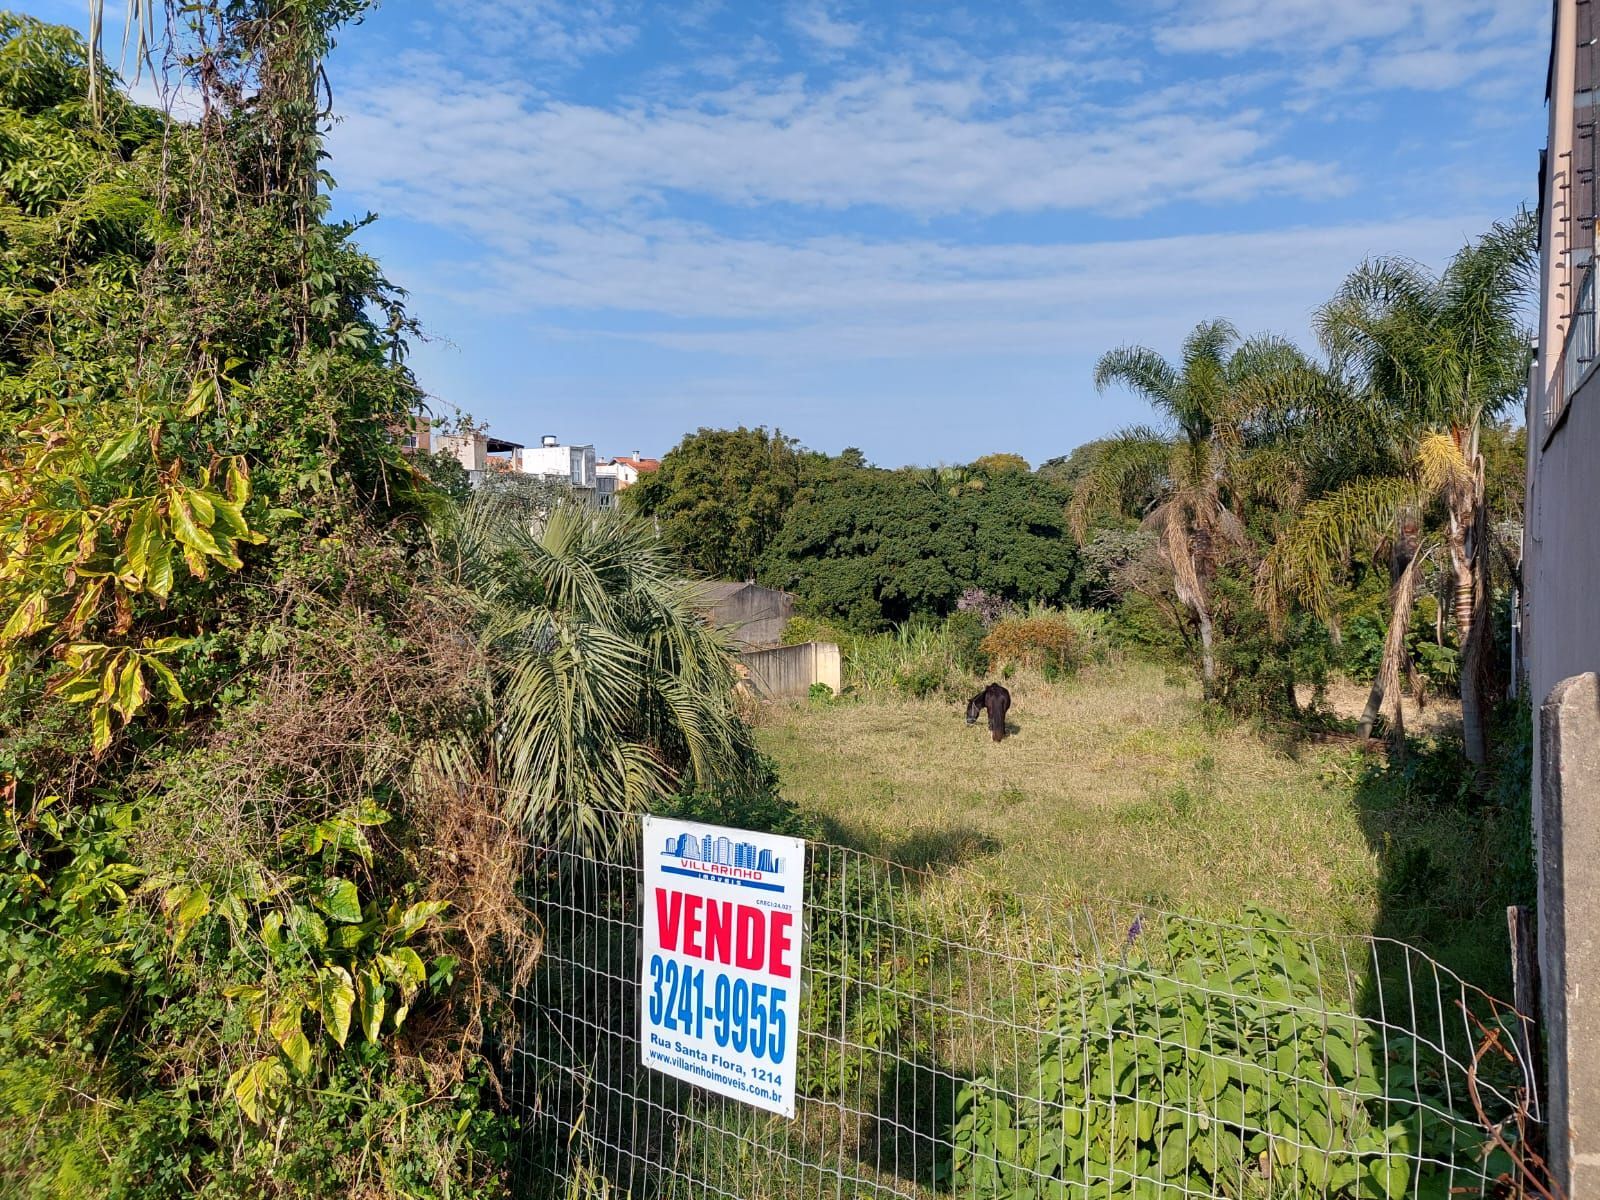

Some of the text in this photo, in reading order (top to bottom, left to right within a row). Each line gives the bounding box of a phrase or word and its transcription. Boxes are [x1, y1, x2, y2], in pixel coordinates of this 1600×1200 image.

[681, 860, 762, 880] VILLARINHO
[655, 887, 792, 979] VENDE
[650, 954, 786, 1064] 3241-9955
[649, 1049, 782, 1103] www.villarinhoimoveis.com.br
[651, 1033, 782, 1087] Rua Santa Flora, 1214
